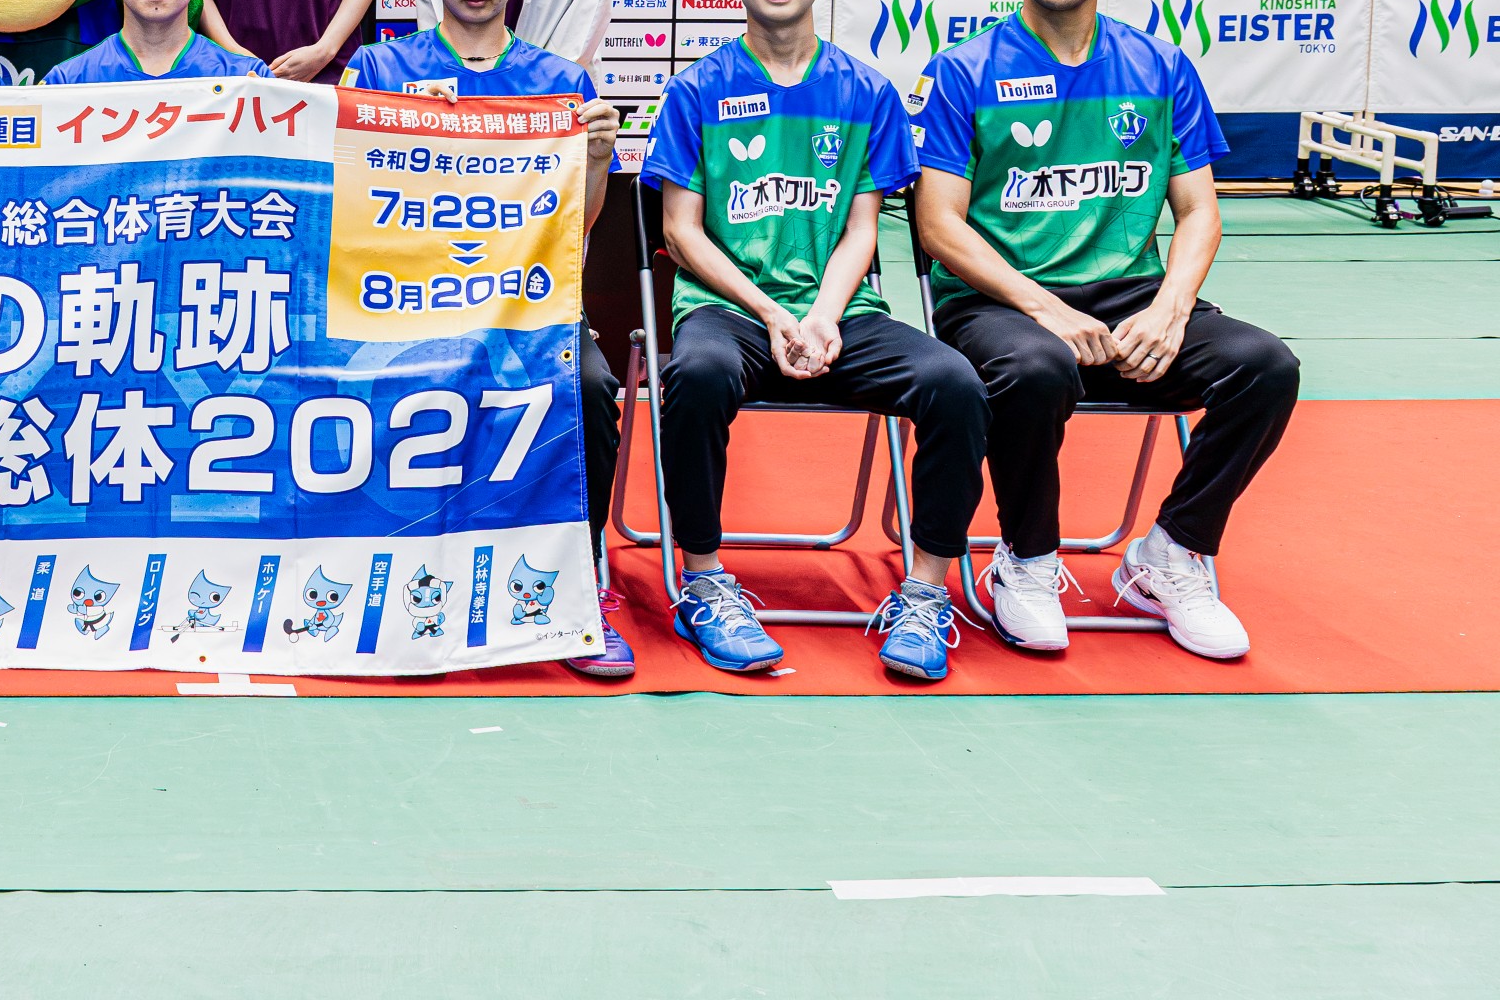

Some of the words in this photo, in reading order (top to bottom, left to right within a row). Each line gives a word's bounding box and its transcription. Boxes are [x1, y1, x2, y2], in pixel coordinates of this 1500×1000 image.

[605, 37, 644, 48] BUTTERFLY
[1299, 43, 1336, 54] TOKYO
[618, 74, 651, 84] 毎日新聞
[56, 98, 309, 145] インターハイ
[356, 102, 574, 134] 東京都の競技開催期間
[1031, 164, 1147, 197] 木下グループ
[370, 189, 523, 231] 7月28日
[1005, 201, 1045, 209] KINOSHITA
[362, 274, 521, 311] 8月20日
[138, 561, 161, 627] ローイング
[255, 563, 276, 615] ホッケー
[367, 562, 387, 608] 空手道
[470, 554, 489, 623] 少林寺拳法
